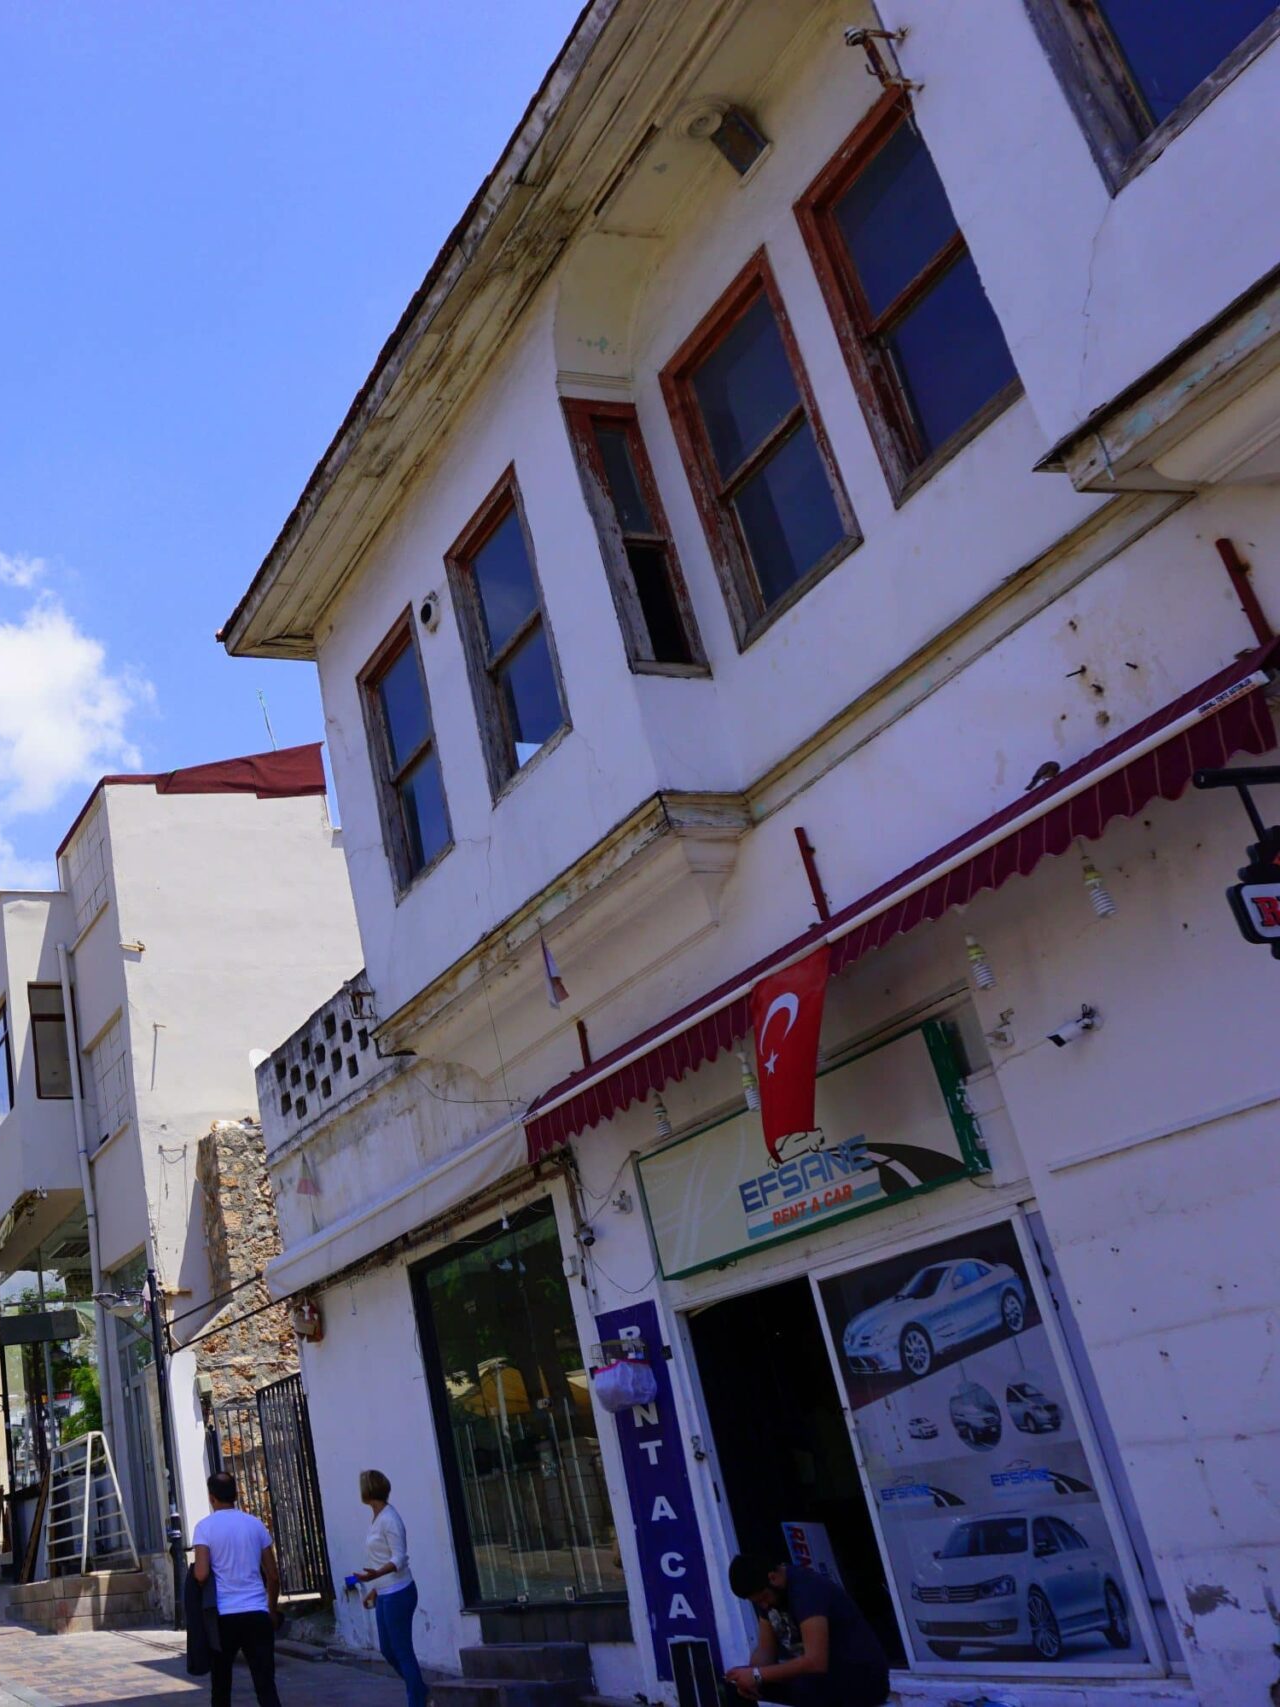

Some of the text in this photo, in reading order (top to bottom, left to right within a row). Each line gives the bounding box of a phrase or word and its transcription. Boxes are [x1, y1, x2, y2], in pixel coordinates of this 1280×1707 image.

[738, 1134, 873, 1214] EFSANE
[772, 1184, 853, 1228] RENT A CAR
[618, 1325, 663, 1466] RNT
[659, 1551, 697, 1642] CA
